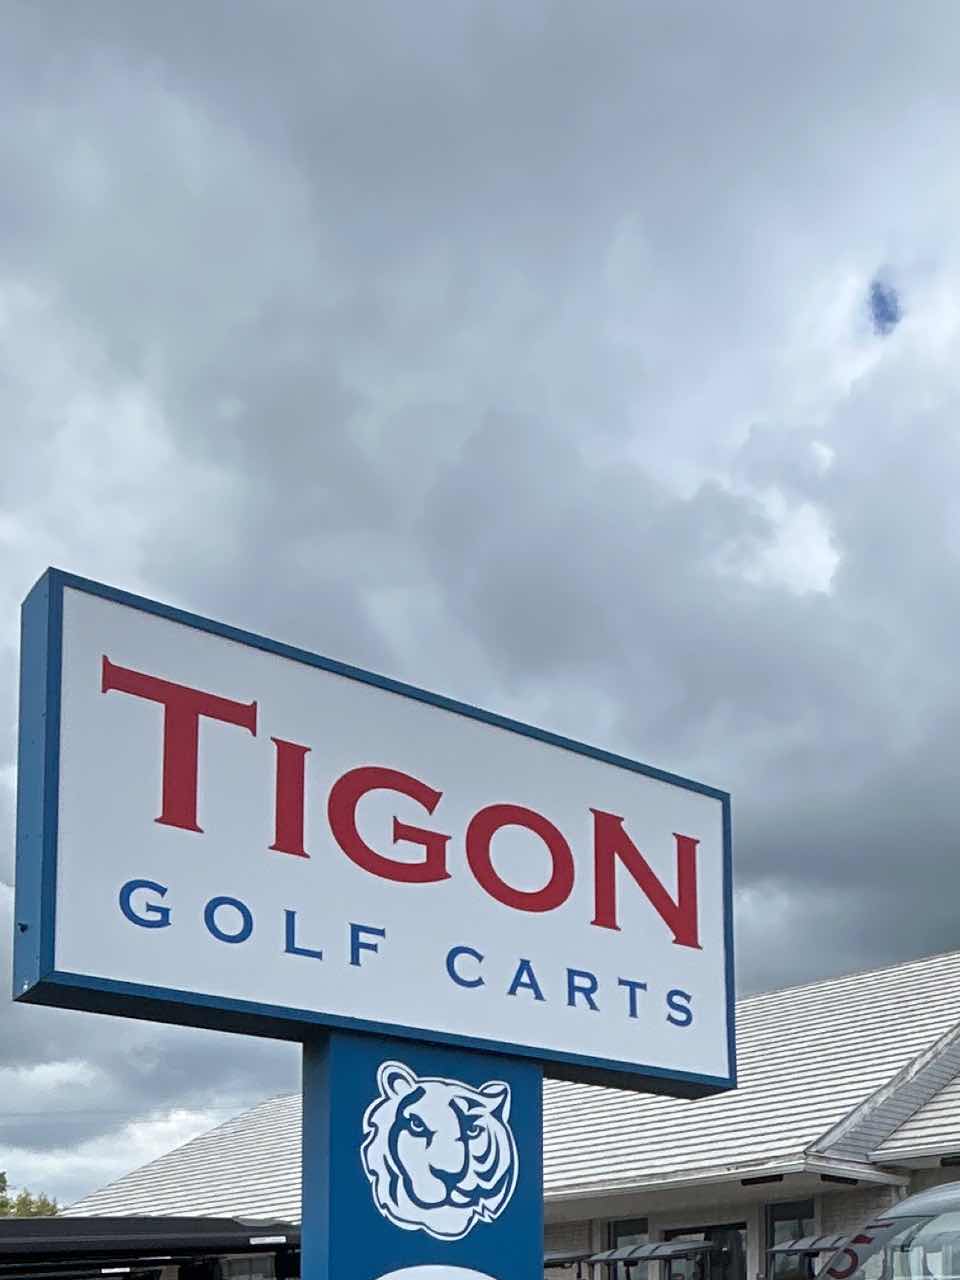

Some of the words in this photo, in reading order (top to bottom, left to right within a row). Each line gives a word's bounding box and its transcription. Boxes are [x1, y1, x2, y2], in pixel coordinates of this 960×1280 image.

[102, 654, 703, 951] TIGON
[118, 879, 387, 967] GOLF
[444, 945, 695, 1028] CARTS
